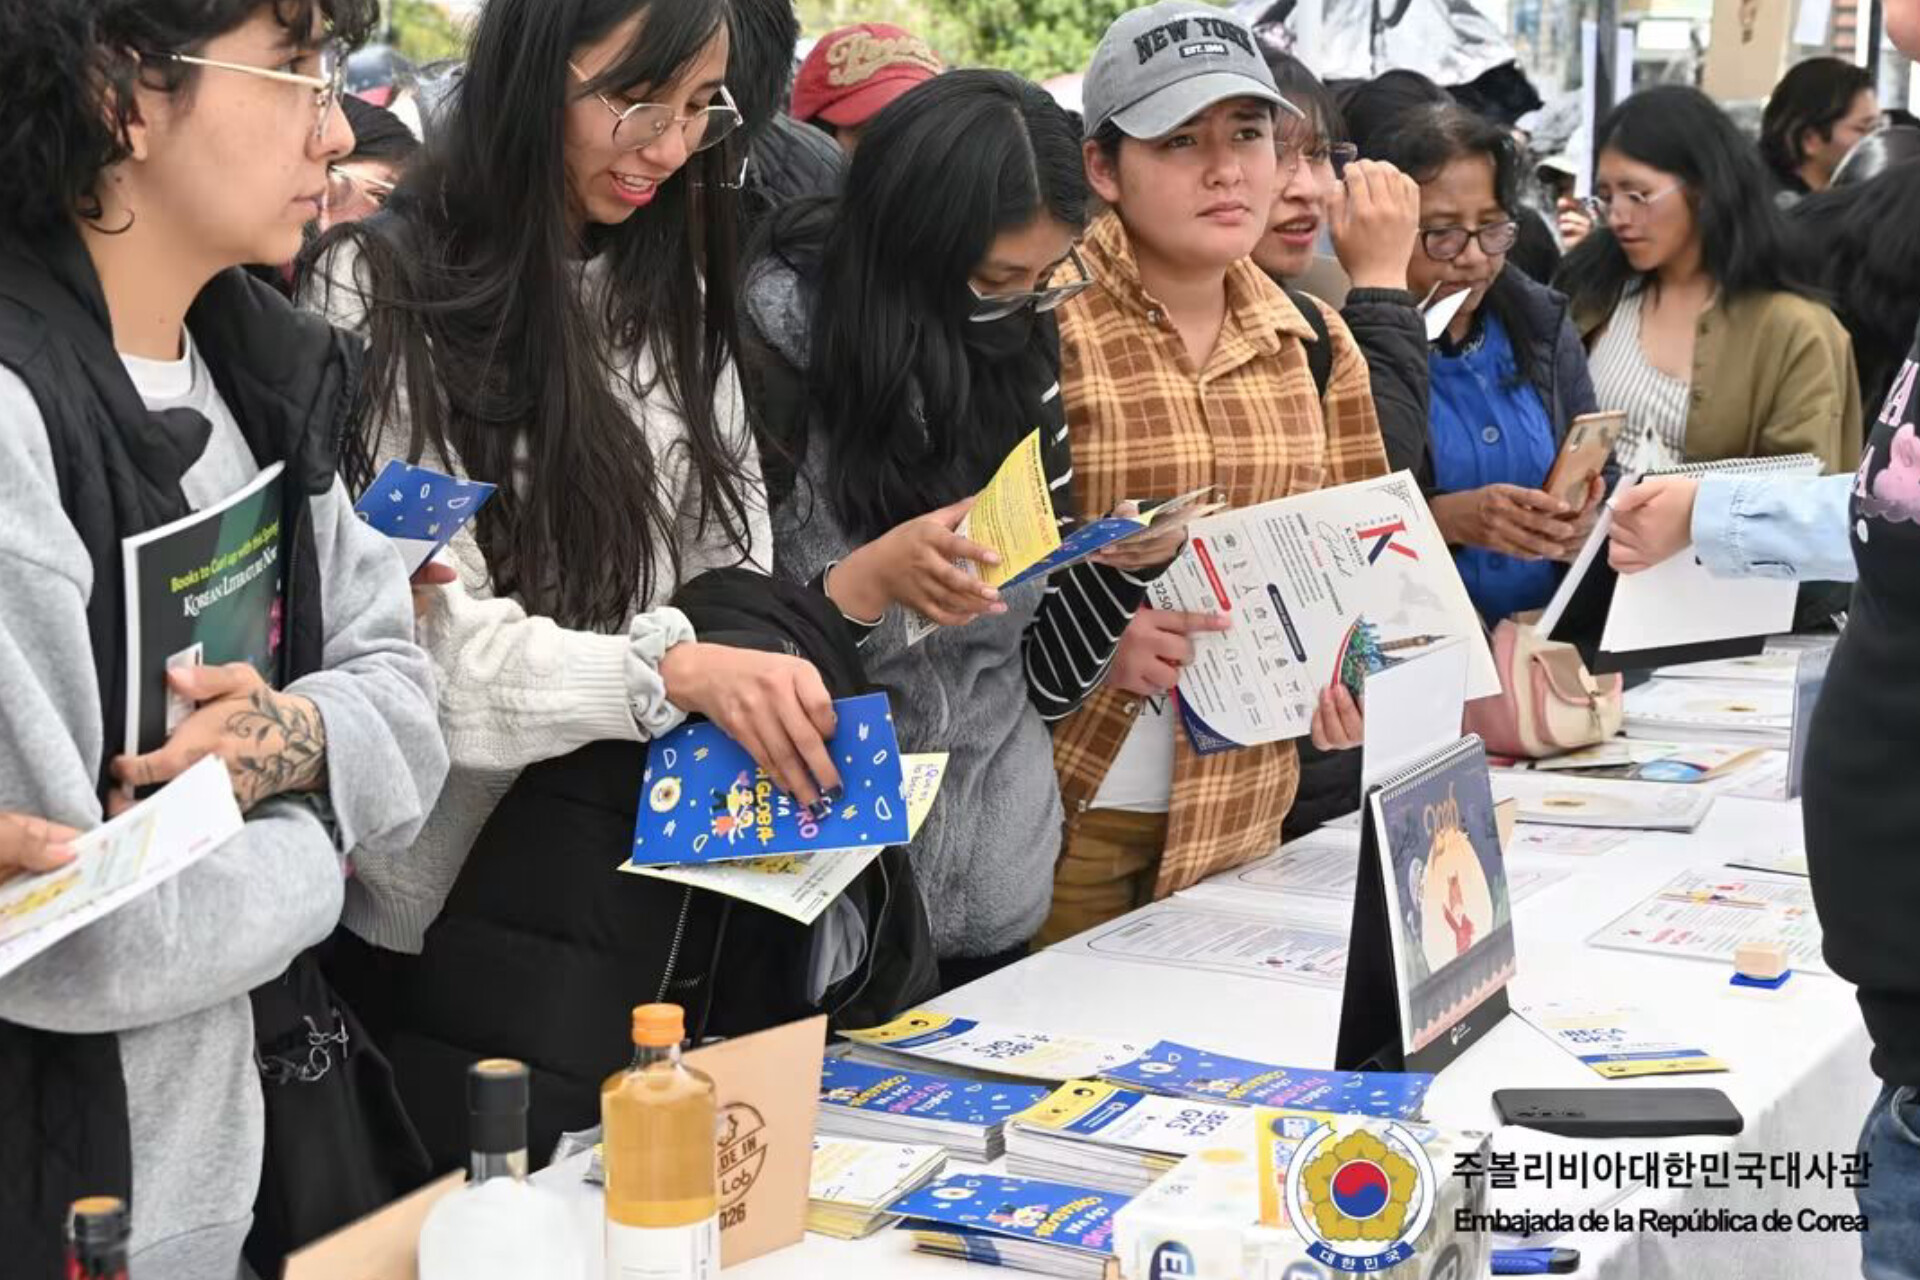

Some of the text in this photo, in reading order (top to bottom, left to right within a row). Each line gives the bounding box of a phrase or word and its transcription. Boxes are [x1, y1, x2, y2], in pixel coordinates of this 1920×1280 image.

[1133, 18, 1255, 65] NEW YORK
[741, 1135, 757, 1156] IN
[719, 1202, 747, 1232] 026
